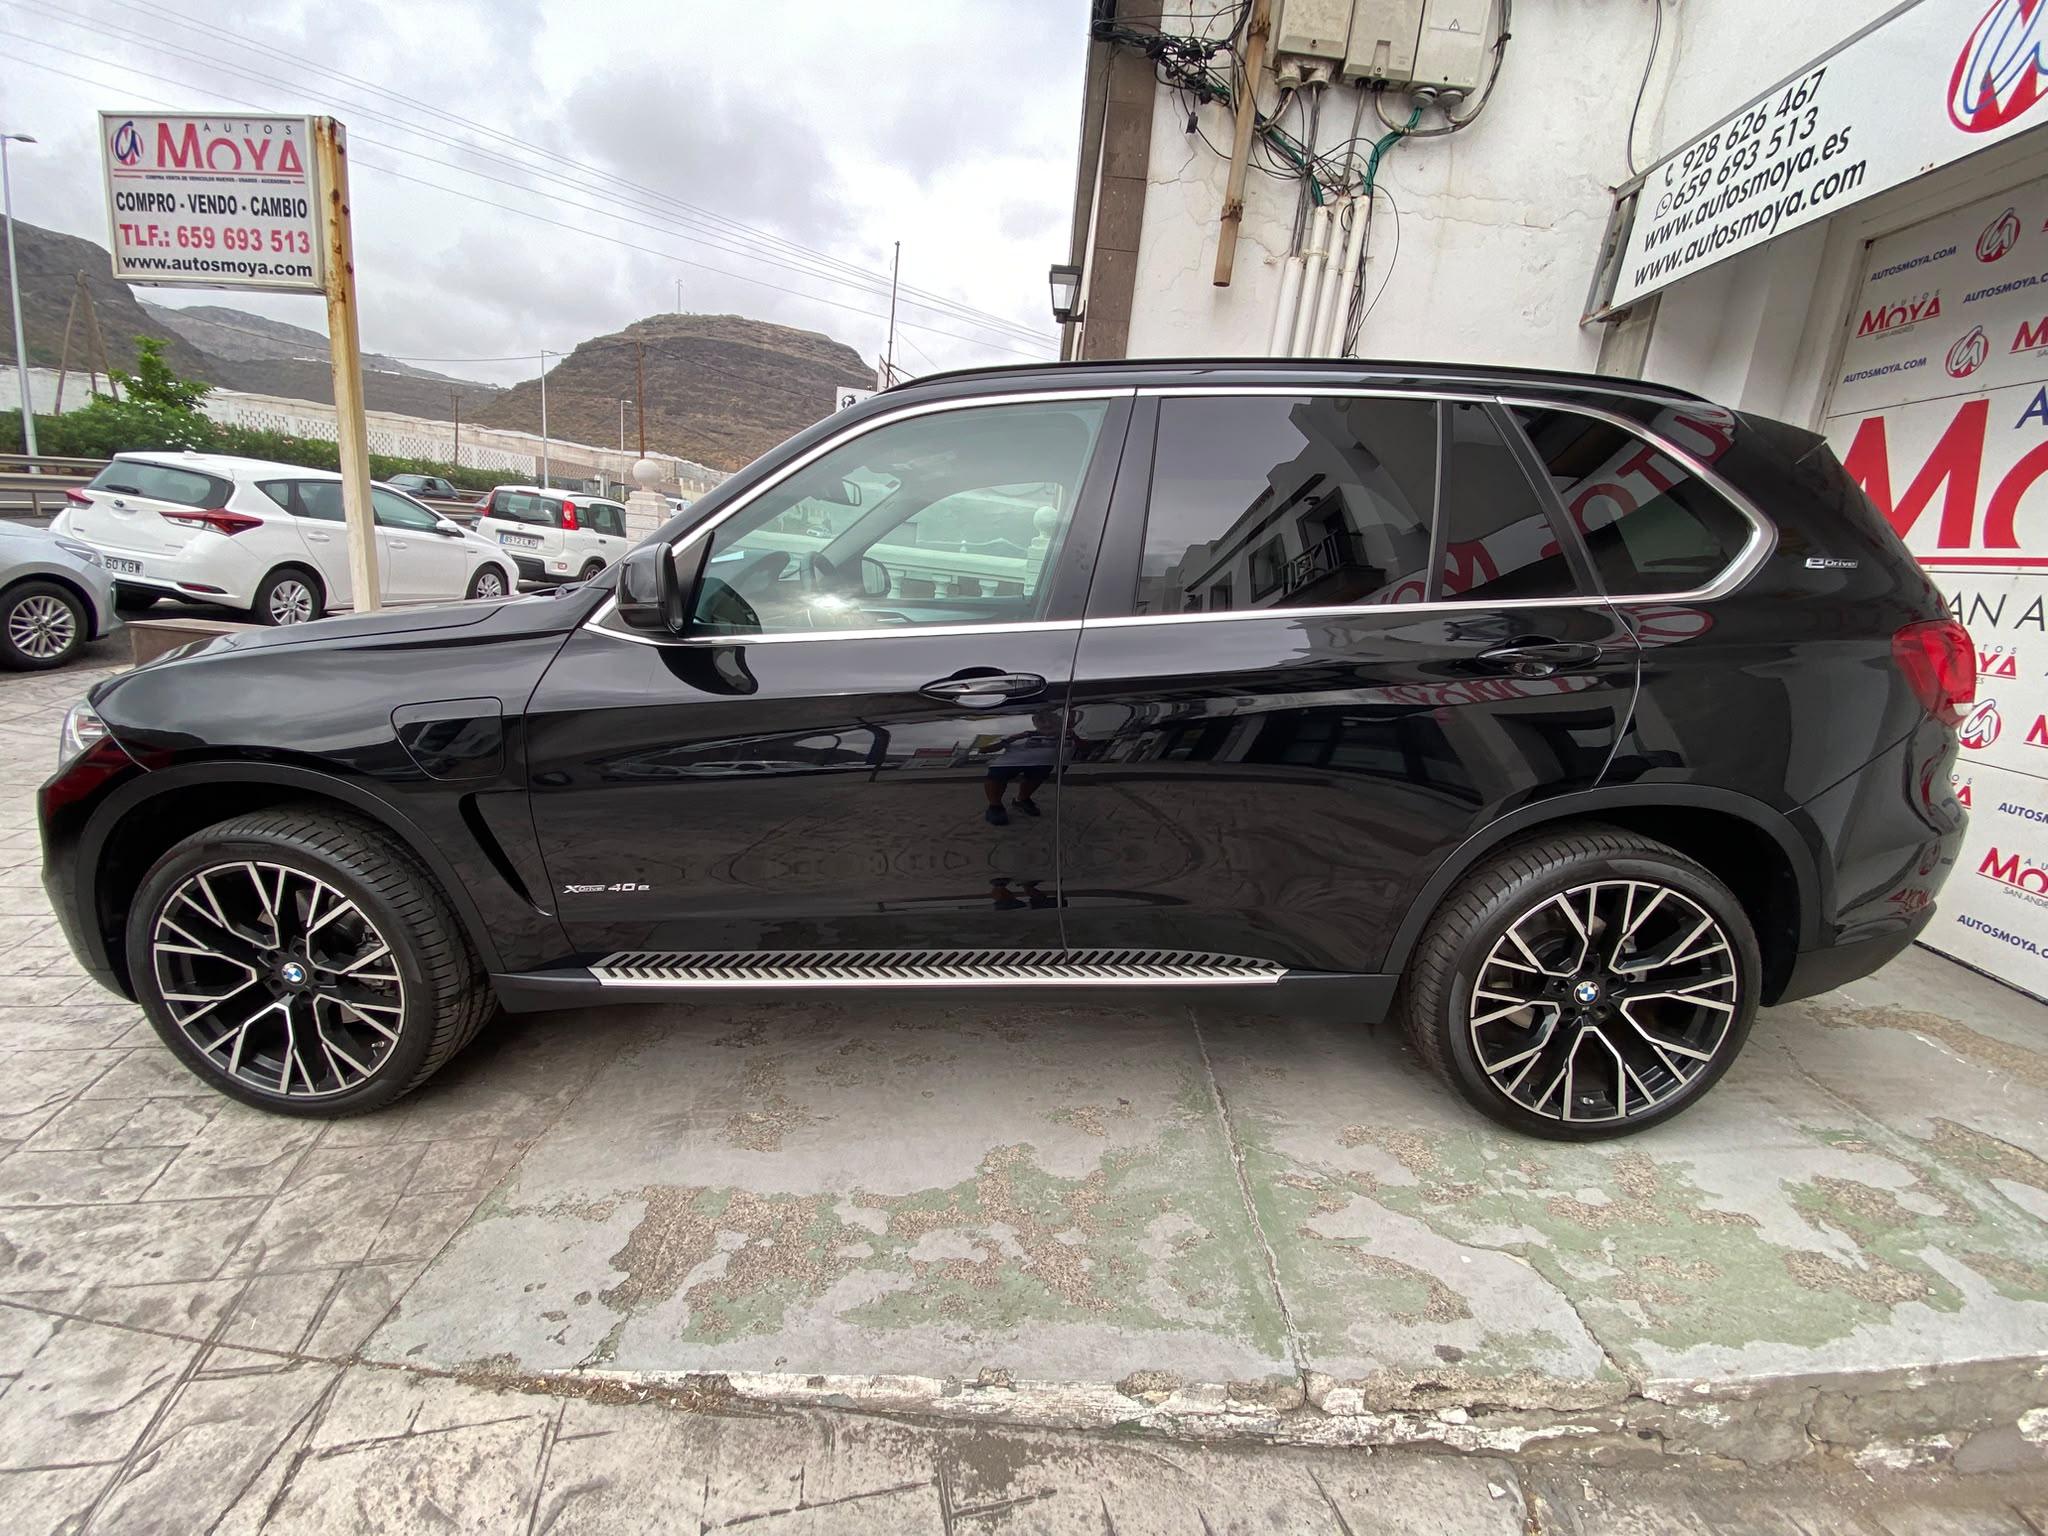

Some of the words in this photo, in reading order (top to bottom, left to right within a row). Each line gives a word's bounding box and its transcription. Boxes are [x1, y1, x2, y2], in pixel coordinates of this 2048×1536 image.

[203, 122, 292, 136] AUTOS
[1681, 133, 1721, 178] 928
[1725, 103, 1769, 150] 626
[1774, 66, 1828, 118] 467
[157, 122, 303, 172] MOYA
[1673, 168, 1712, 211] 659
[1717, 139, 1760, 185] 693
[1765, 106, 1818, 159] 513
[116, 192, 176, 213] COMPRO
[188, 194, 238, 215] VENDO
[250, 196, 308, 219] CAMBIO
[1643, 126, 1852, 253] www.autosmoya.es
[119, 223, 170, 247] TLF.:
[177, 226, 216, 249] 659
[223, 227, 262, 252] 693
[271, 229, 311, 254] 513
[1634, 160, 1867, 288] www.autosmoya.com
[122, 255, 313, 278] www.autosmoya.com
[1870, 245, 1957, 283] AUTOSMOYA.COM
[1858, 296, 1940, 335] MOYA
[1842, 357, 1928, 384] AUTOSMOYA.COM
